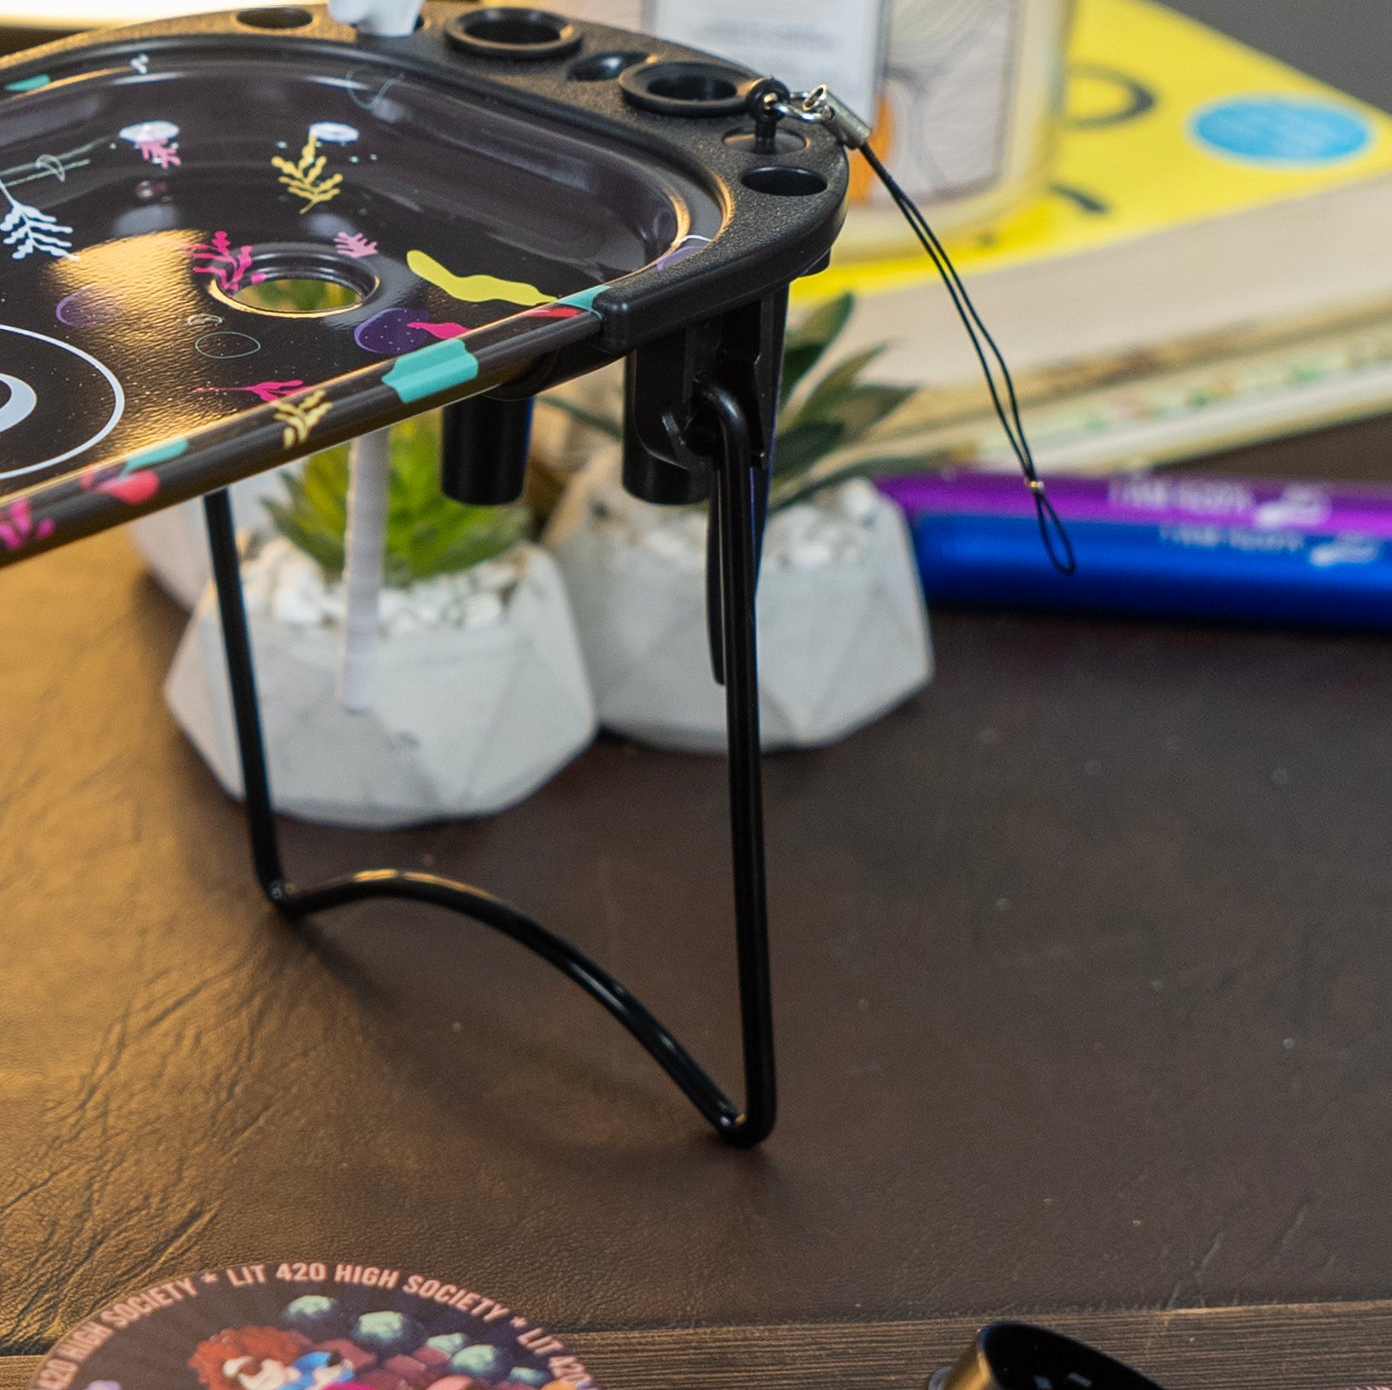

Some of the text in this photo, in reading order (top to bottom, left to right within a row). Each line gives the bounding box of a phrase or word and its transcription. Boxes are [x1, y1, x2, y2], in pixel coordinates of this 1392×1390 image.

[61, 1321, 114, 1362] HIGH
[101, 1277, 199, 1330] SOCIETY
[226, 1262, 510, 1323] LIT 420 HIGH SOCIETY
